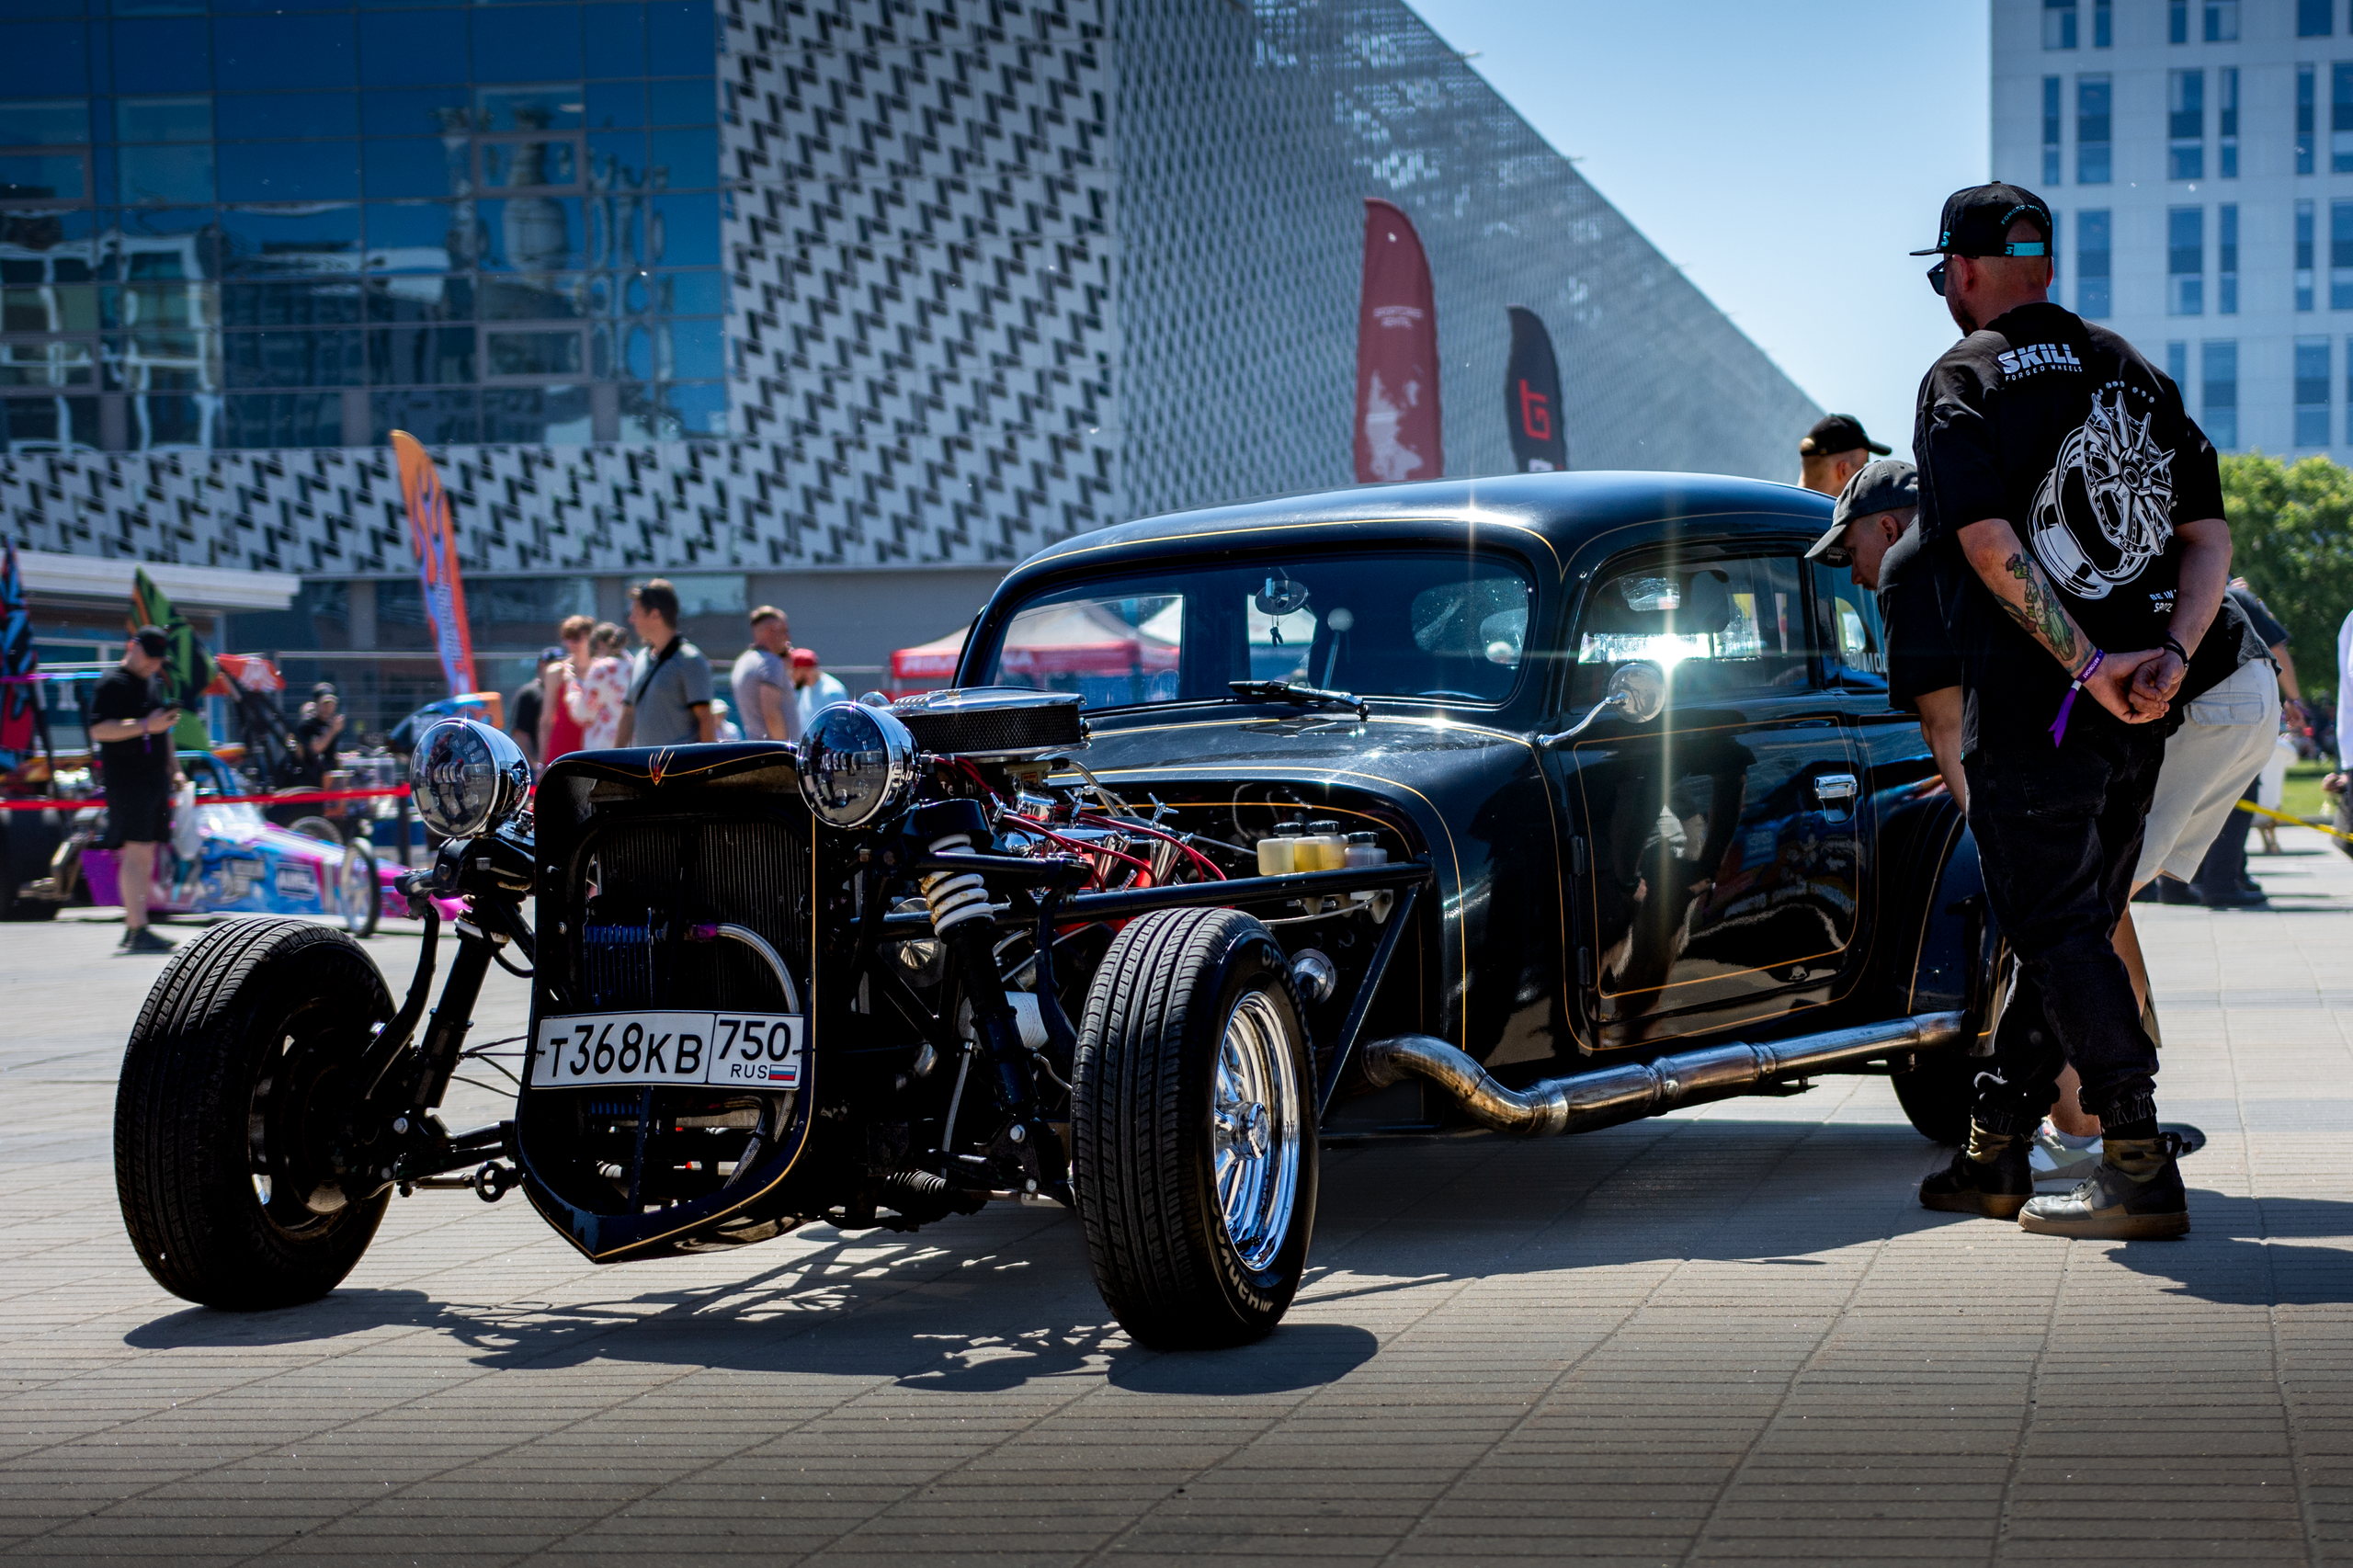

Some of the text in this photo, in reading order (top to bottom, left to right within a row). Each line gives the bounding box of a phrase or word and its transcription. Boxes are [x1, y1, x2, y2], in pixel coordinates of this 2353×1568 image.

[2001, 205, 2025, 225] FORGED
[2005, 246, 2014, 255] S
[1997, 343, 2081, 374] SKILL
[2005, 364, 2083, 382] FORGED WHEELS
[718, 1019, 792, 1062] 750
[731, 1063, 767, 1080] RUS
